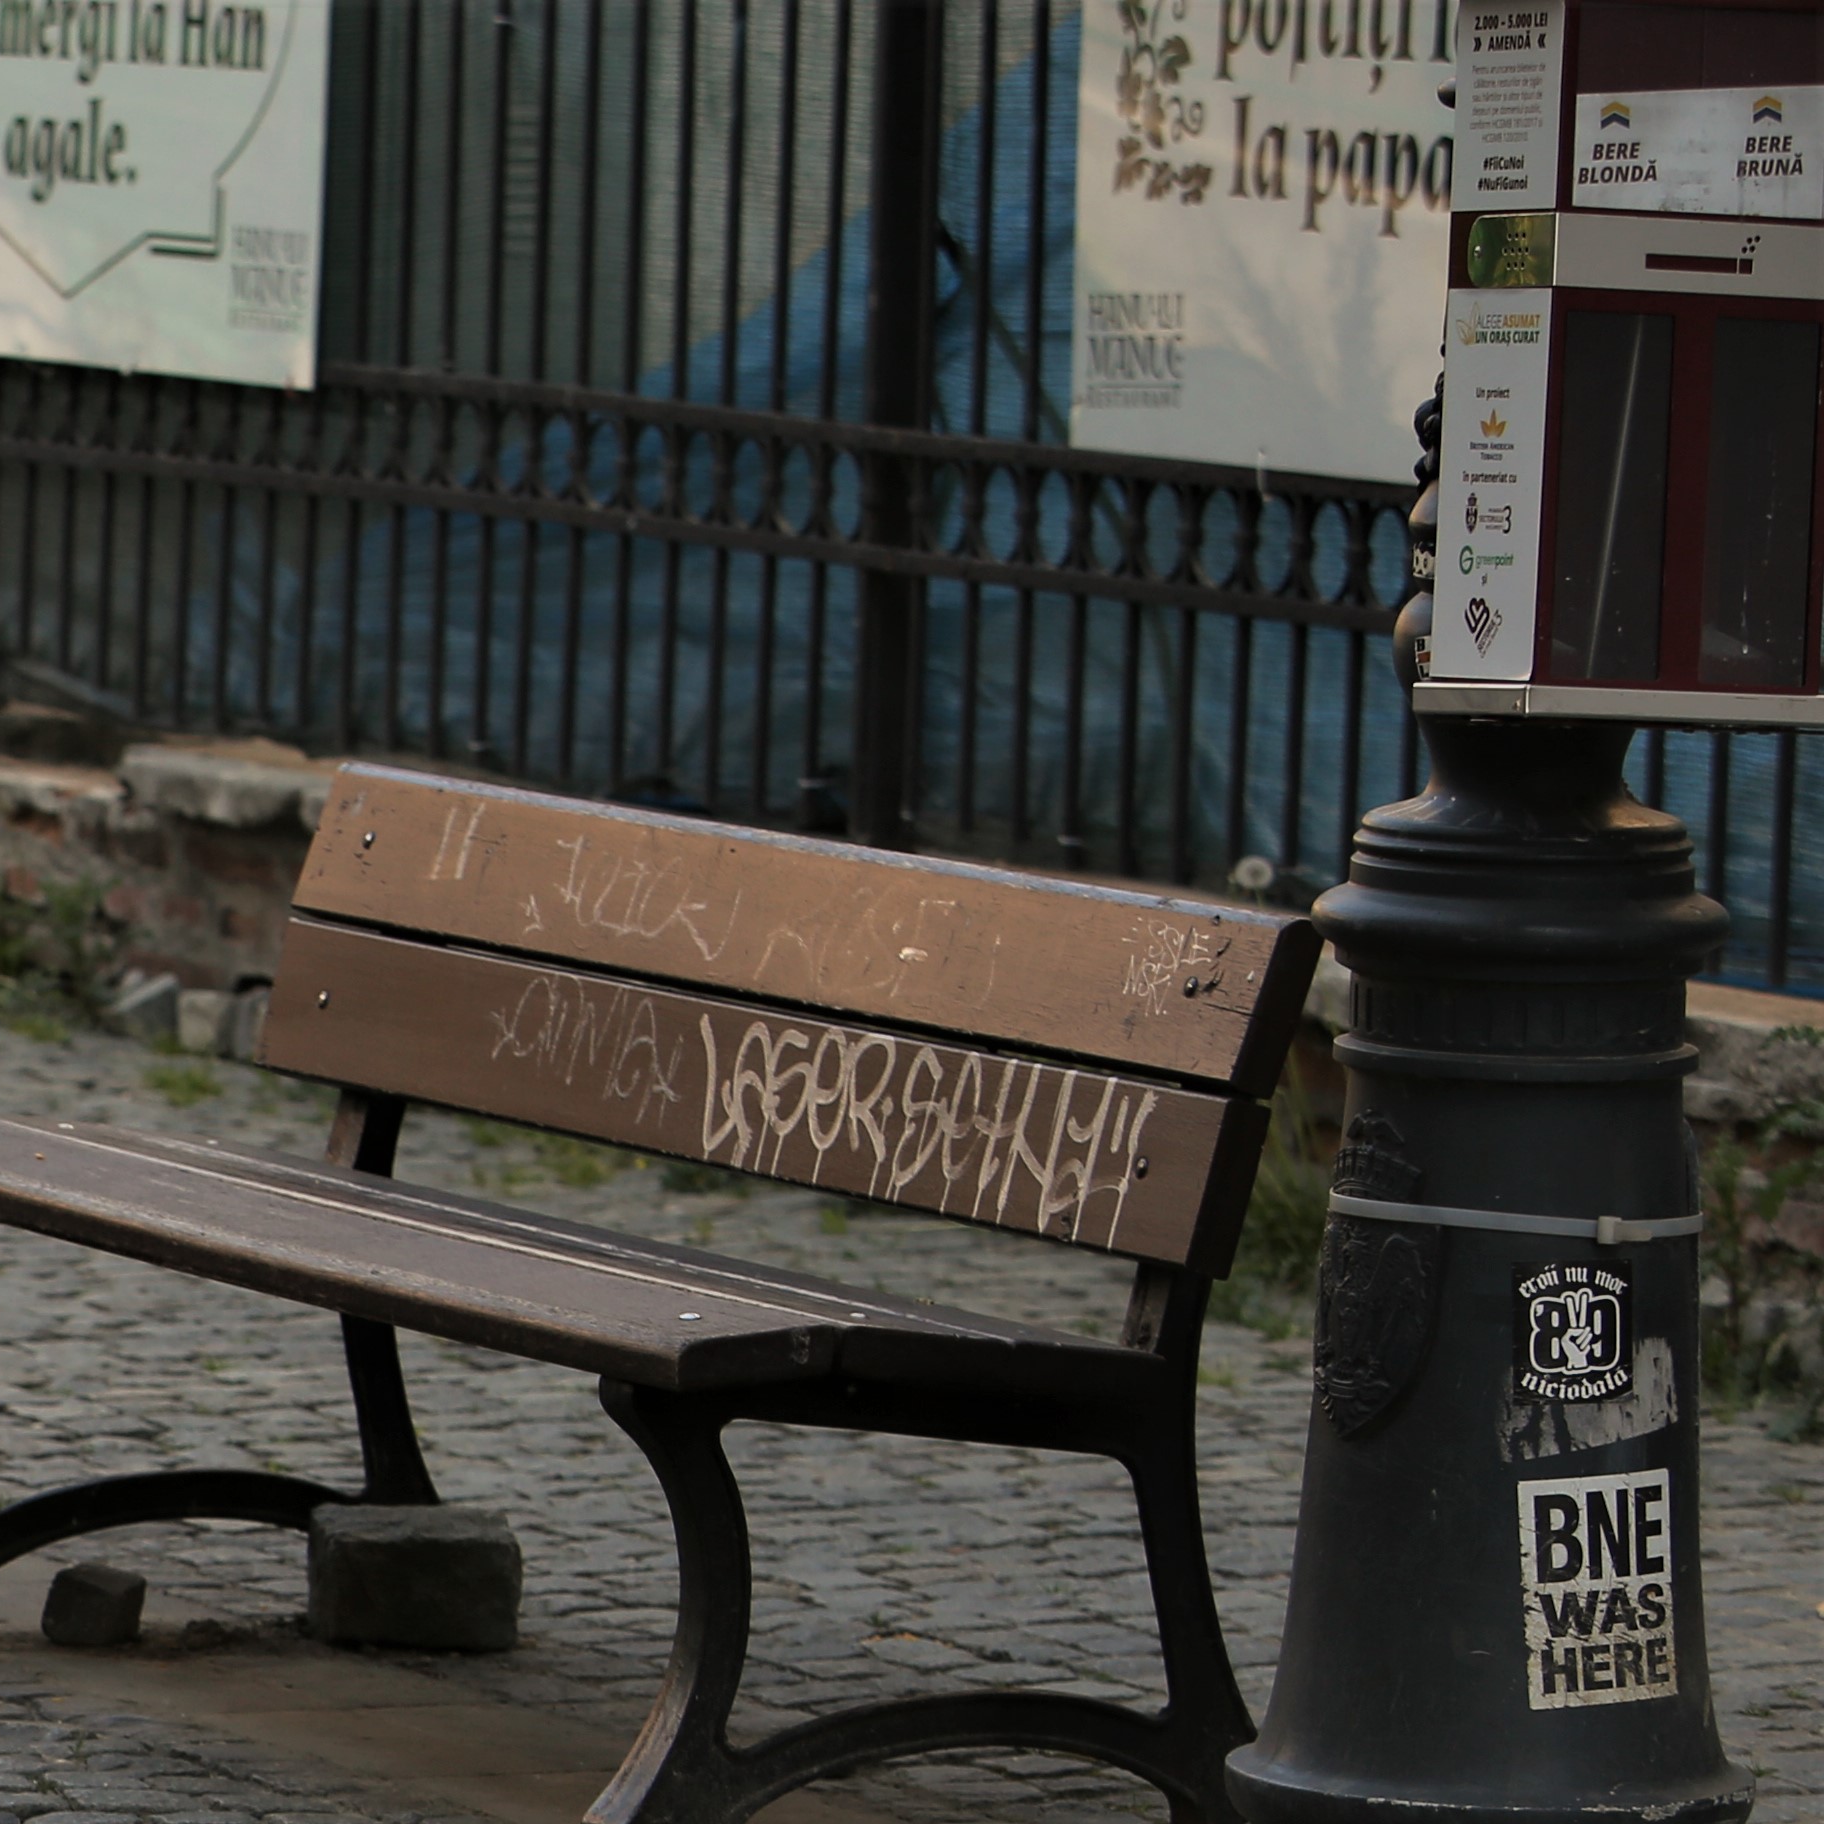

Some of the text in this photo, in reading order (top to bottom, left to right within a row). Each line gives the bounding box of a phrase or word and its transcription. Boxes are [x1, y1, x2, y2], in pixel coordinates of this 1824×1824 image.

[1534, 12, 1548, 28] LEI
[180, 0, 265, 71] Han
[1487, 29, 1532, 52] AMENDĂ
[5, 98, 137, 203] agale.
[1230, 97, 1289, 200] la
[1592, 142, 1641, 161] BERE
[1745, 135, 1793, 154] BERE
[1577, 159, 1658, 185] BLONDĂ
[1736, 153, 1804, 178] BRUNĂ
[1512, 331, 1540, 344] CURAT
[1565, 1267, 1588, 1283] nu
[1533, 1484, 1665, 1584] BNE
[1538, 1583, 1667, 1639] WAS
[1539, 1638, 1671, 1695] HERE
